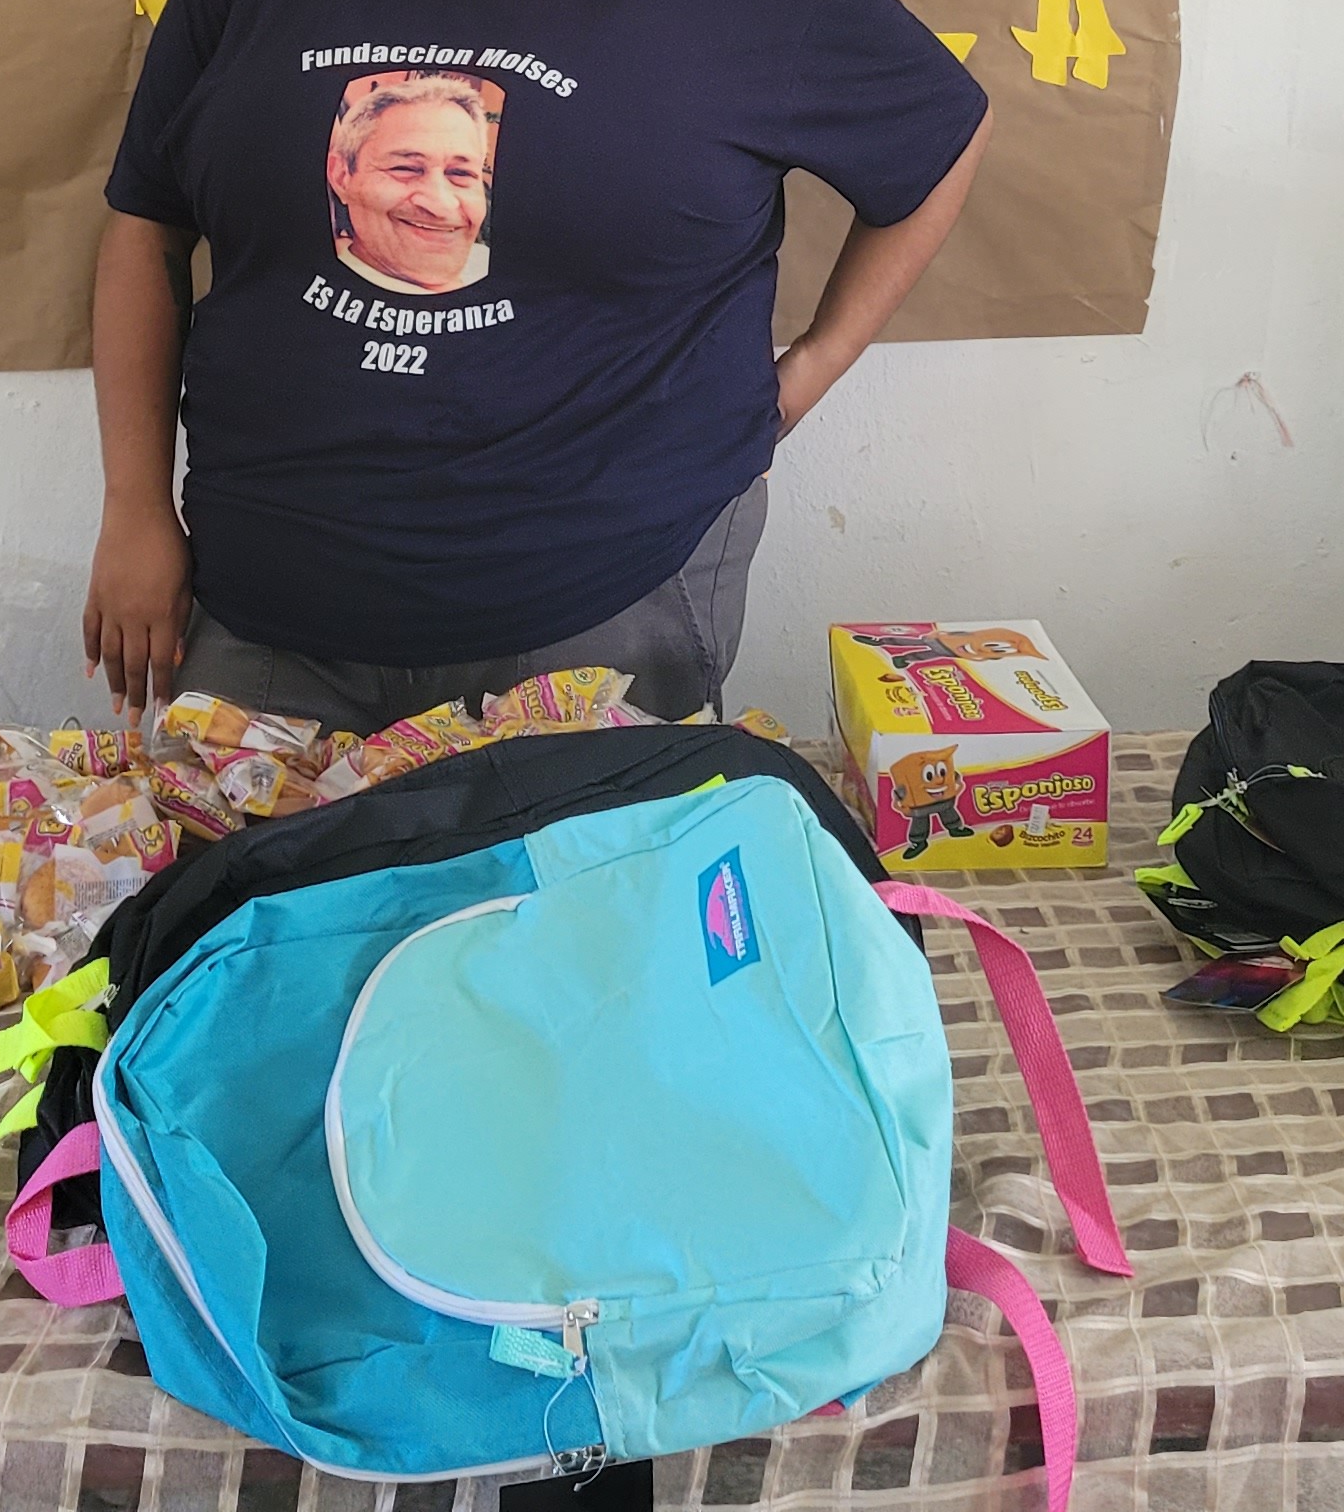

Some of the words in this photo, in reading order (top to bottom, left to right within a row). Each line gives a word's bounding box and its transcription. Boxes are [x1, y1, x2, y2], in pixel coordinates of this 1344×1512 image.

[301, 42, 475, 72] Fundaccion
[475, 47, 579, 99] Moises
[302, 274, 334, 312] Es
[333, 289, 363, 324] La
[364, 298, 515, 336] Esperanza
[360, 340, 429, 376] 2022
[972, 772, 1094, 815] Esponjoso
[1073, 827, 1093, 840] 24
[720, 861, 747, 961] TRAILMAKER
